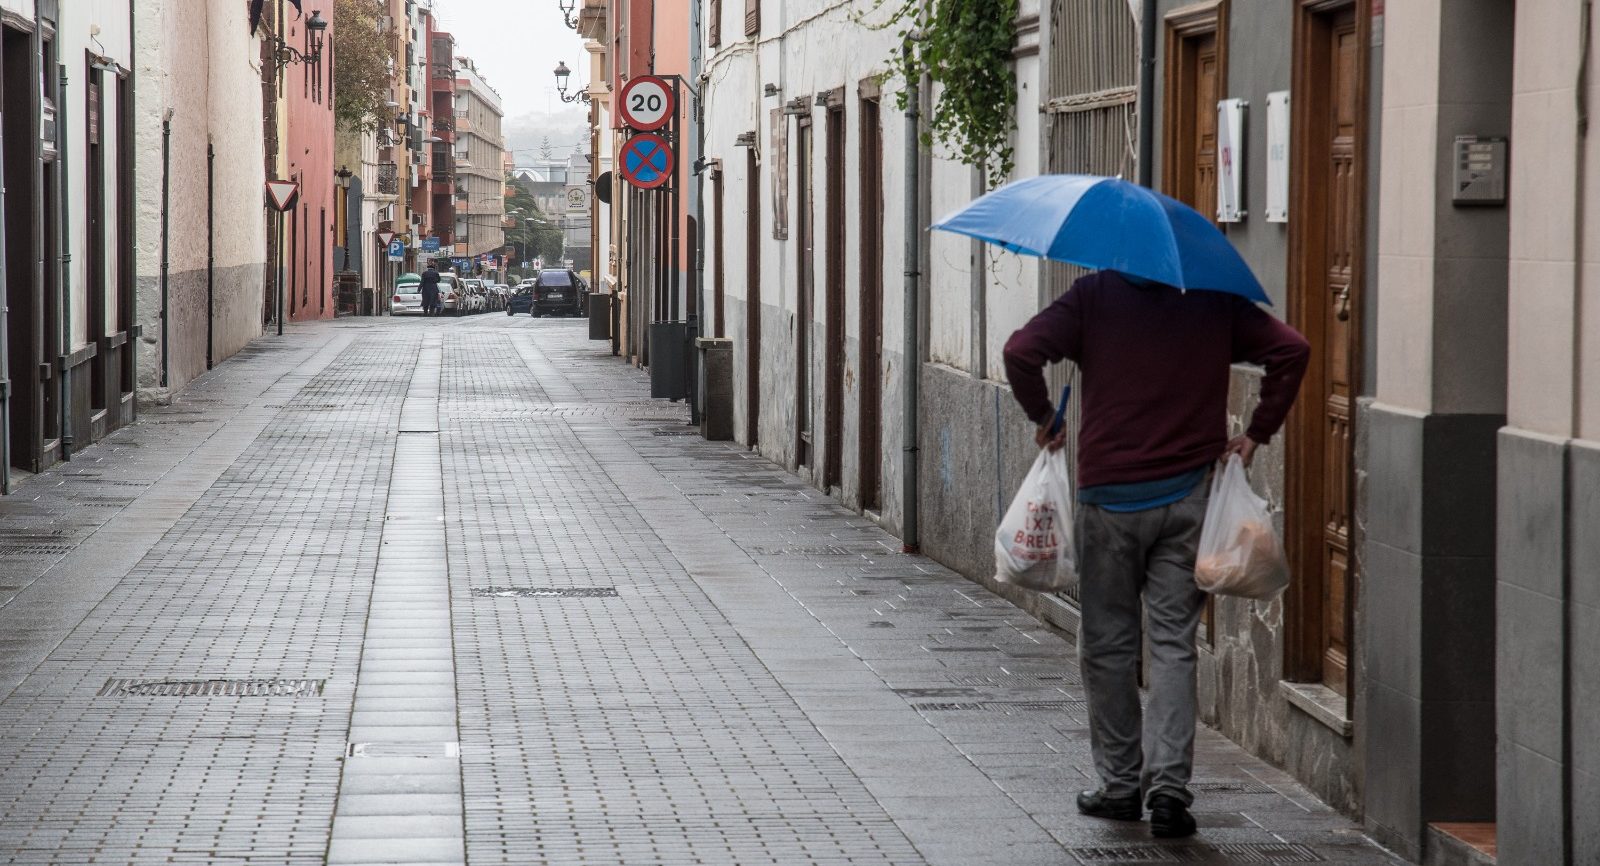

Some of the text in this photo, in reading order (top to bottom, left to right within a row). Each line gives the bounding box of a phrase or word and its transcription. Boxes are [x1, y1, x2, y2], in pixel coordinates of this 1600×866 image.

[632, 94, 661, 112] 20
[391, 243, 400, 254] P
[462, 261, 469, 270] P
